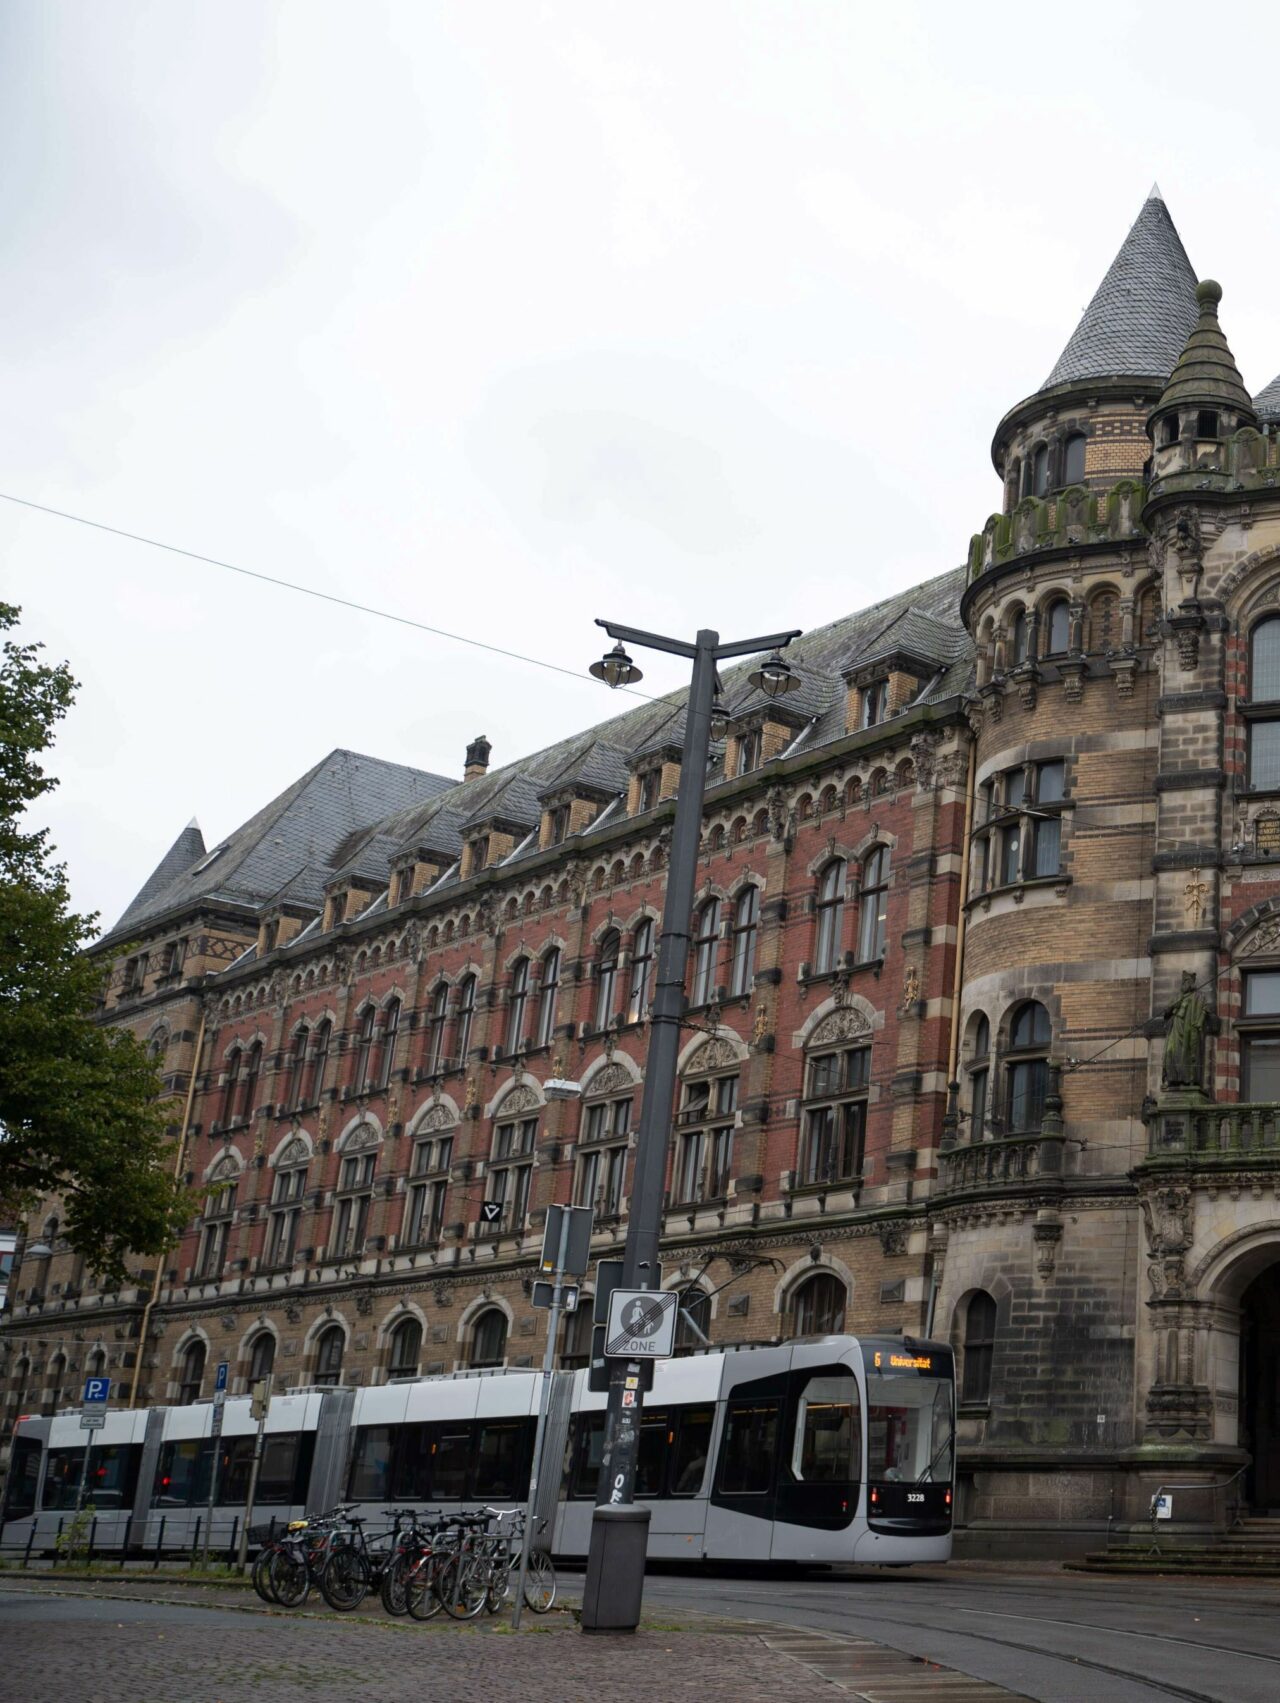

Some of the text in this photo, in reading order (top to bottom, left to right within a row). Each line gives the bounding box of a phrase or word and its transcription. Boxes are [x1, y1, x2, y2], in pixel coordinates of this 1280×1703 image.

[622, 1340, 656, 1352] ZONE
[87, 1380, 103, 1399] P
[907, 1493, 925, 1502] 3228
